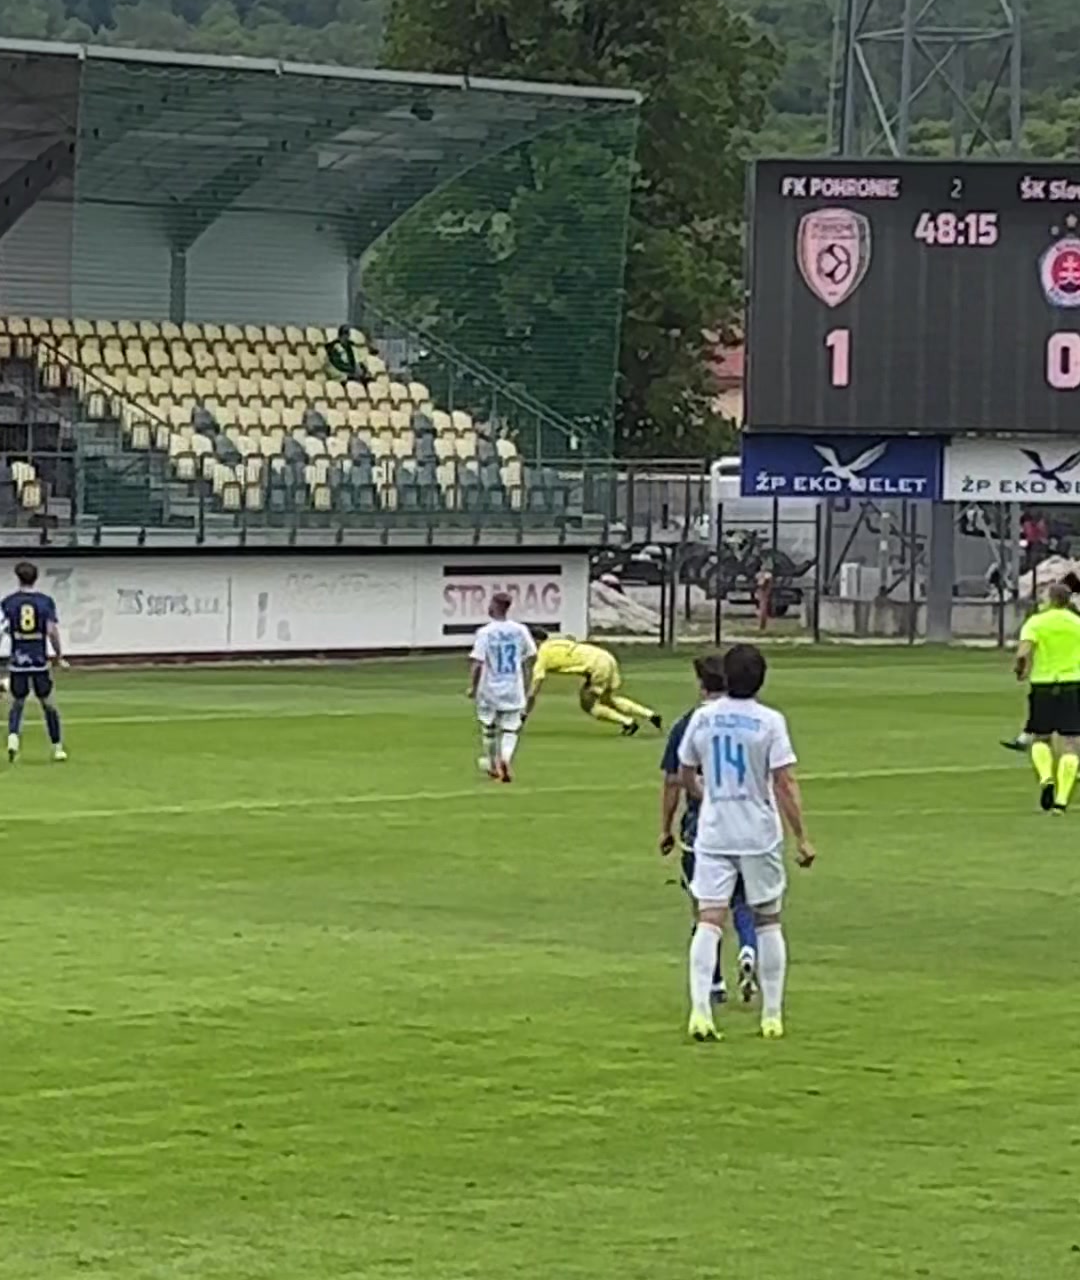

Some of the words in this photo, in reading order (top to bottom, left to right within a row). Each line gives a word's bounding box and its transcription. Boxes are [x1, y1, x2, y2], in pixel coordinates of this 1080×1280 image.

[781, 177, 807, 197] FK
[810, 177, 900, 198] POHRONIE
[950, 178, 963, 199] 2
[1020, 175, 1046, 200] ŠK
[913, 211, 999, 245] 48:15
[825, 328, 850, 387] 1
[1046, 332, 1080, 389] 0
[755, 471, 787, 492] ŽP
[793, 476, 842, 492] EKO
[961, 475, 991, 493] ŽP
[999, 479, 1047, 494] EKO
[19, 604, 36, 633] 8
[496, 644, 517, 673] 13
[712, 734, 747, 789] 14
